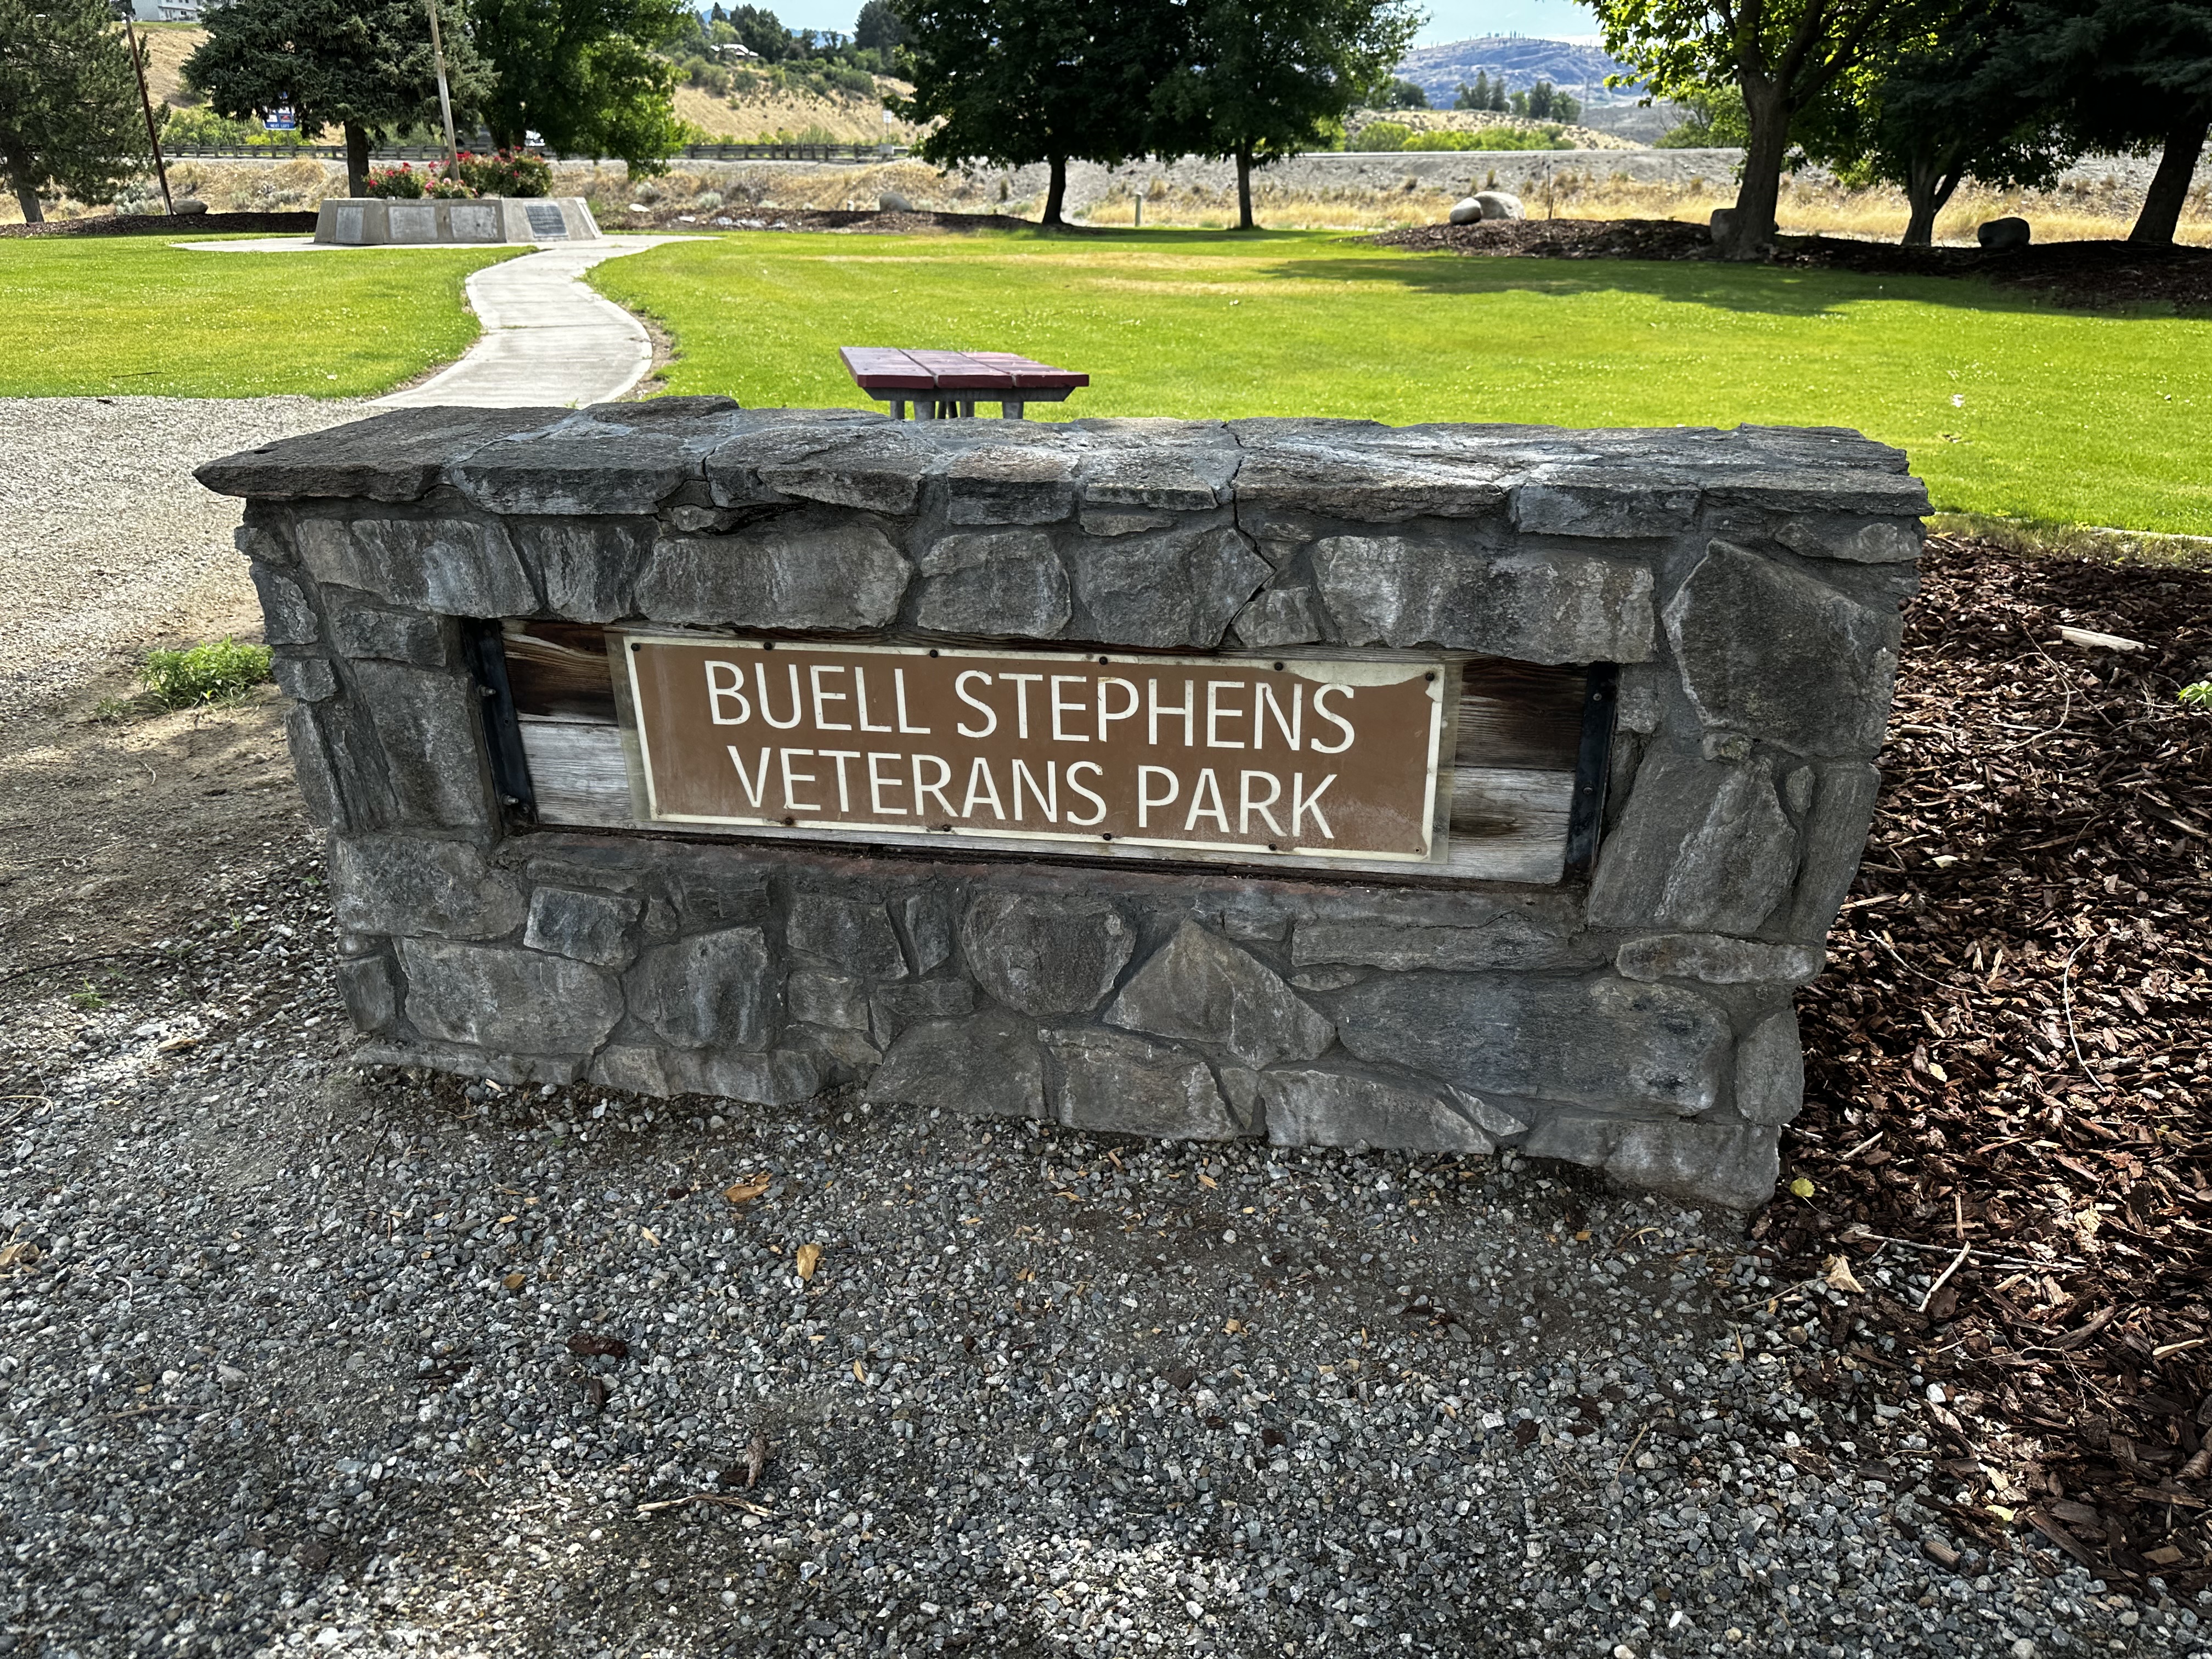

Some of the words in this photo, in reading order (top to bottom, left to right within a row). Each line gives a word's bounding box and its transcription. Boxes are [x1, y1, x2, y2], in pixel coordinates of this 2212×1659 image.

[704, 660, 931, 734] BUELL
[955, 670, 1356, 754] STEPHENS
[726, 745, 1107, 826] VETERANS
[1138, 765, 1338, 839] PARK
